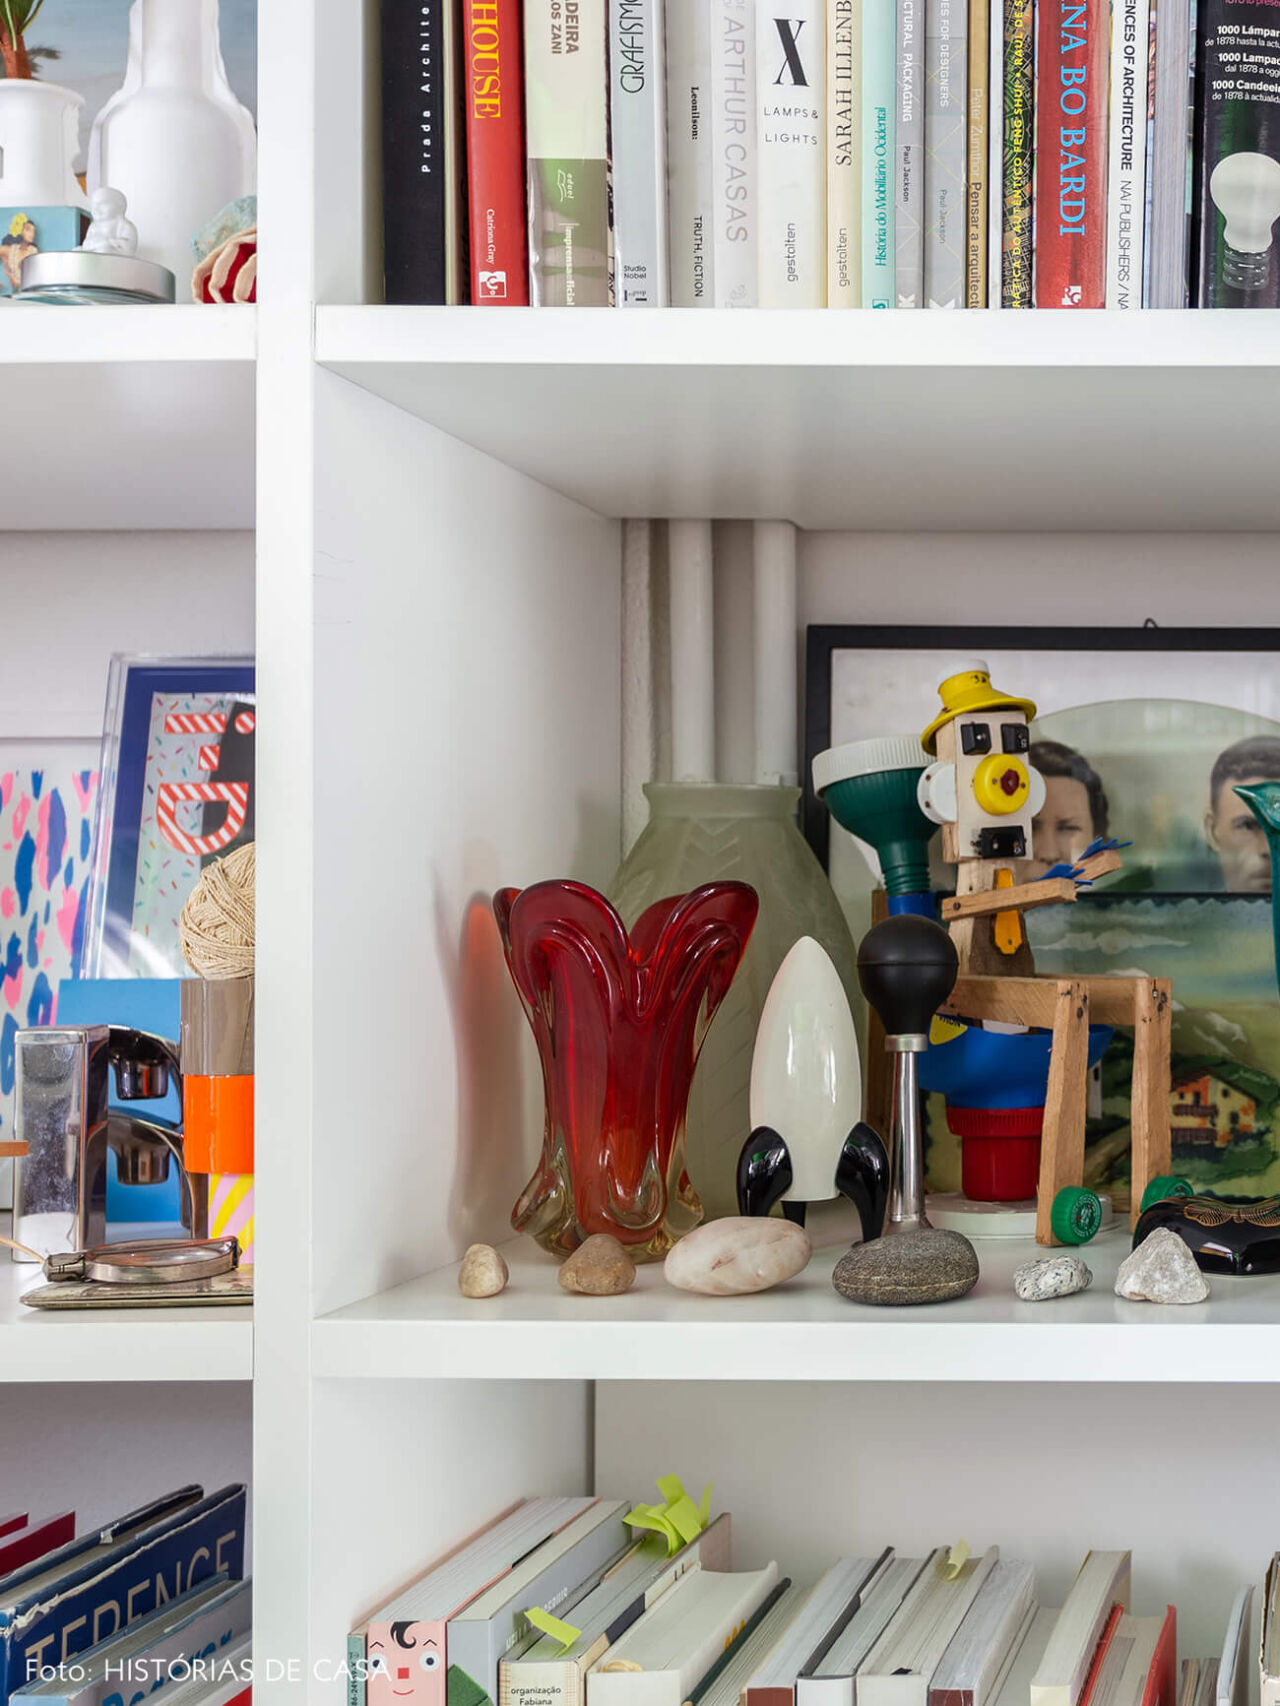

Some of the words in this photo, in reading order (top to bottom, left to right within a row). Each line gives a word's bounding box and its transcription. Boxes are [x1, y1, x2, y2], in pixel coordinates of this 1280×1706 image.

[565, 0, 579, 54] DEIRA
[940, 19, 950, 40] FOR
[1014, 13, 1024, 28] DE
[1060, 0, 1087, 54] NA
[1217, 25, 1240, 35] 1000
[551, 24, 562, 54] ZANI
[619, 0, 645, 93] GRAFISM
[772, 18, 810, 87] X
[1014, 36, 1024, 65] RAUL
[1123, 45, 1135, 65] OF
[1204, 39, 1214, 47] de
[1216, 37, 1236, 45] 1878
[1236, 37, 1257, 46] hasta
[1258, 38, 1265, 47] la
[471, 0, 502, 118] HOUSE
[1218, 53, 1241, 62] 1000
[1224, 65, 1236, 73] dal
[1239, 65, 1258, 73] 1878
[1265, 68, 1280, 78] oggi
[723, 16, 747, 134] ARTHUR
[902, 53, 914, 122] PACKAGING
[940, 44, 950, 107] DESIGNERS
[1060, 65, 1087, 116] BO
[1212, 80, 1234, 90] 1000
[972, 88, 983, 120] Peter
[1013, 84, 1023, 115] SHUI
[1211, 92, 1222, 100] de
[1224, 91, 1243, 100] 1878
[690, 87, 700, 140] Leonilson:
[763, 107, 809, 118] LAMPS
[811, 109, 819, 119] &
[835, 90, 852, 166] SARAH
[1120, 67, 1135, 171] ARCHITECTURE
[421, 110, 432, 173] Prada
[765, 133, 818, 146] LIGHTS
[874, 107, 887, 156] Ocidental
[1013, 121, 1022, 153] FENG
[903, 146, 911, 164] Paul
[724, 143, 748, 243] CASAS
[875, 159, 887, 210] Mobiliário
[902, 167, 911, 202] Jackson
[938, 189, 947, 207] Paul
[1059, 127, 1086, 237] BARDI
[875, 212, 887, 226] do
[970, 182, 982, 228] Pensar
[486, 209, 496, 243] Catriona
[694, 216, 703, 253] TRUTH,
[938, 210, 947, 244] Jackson
[970, 232, 980, 241] a
[1118, 204, 1131, 282] PUBLISHERS
[487, 244, 496, 265] Gray
[785, 223, 799, 282] gestalten
[838, 227, 850, 287] gestalten
[875, 227, 887, 266] História
[1012, 236, 1021, 255] DO
[694, 256, 704, 298] FICTION
[510, 1686, 562, 1696] organização
[519, 1698, 552, 1706] Fabiana
